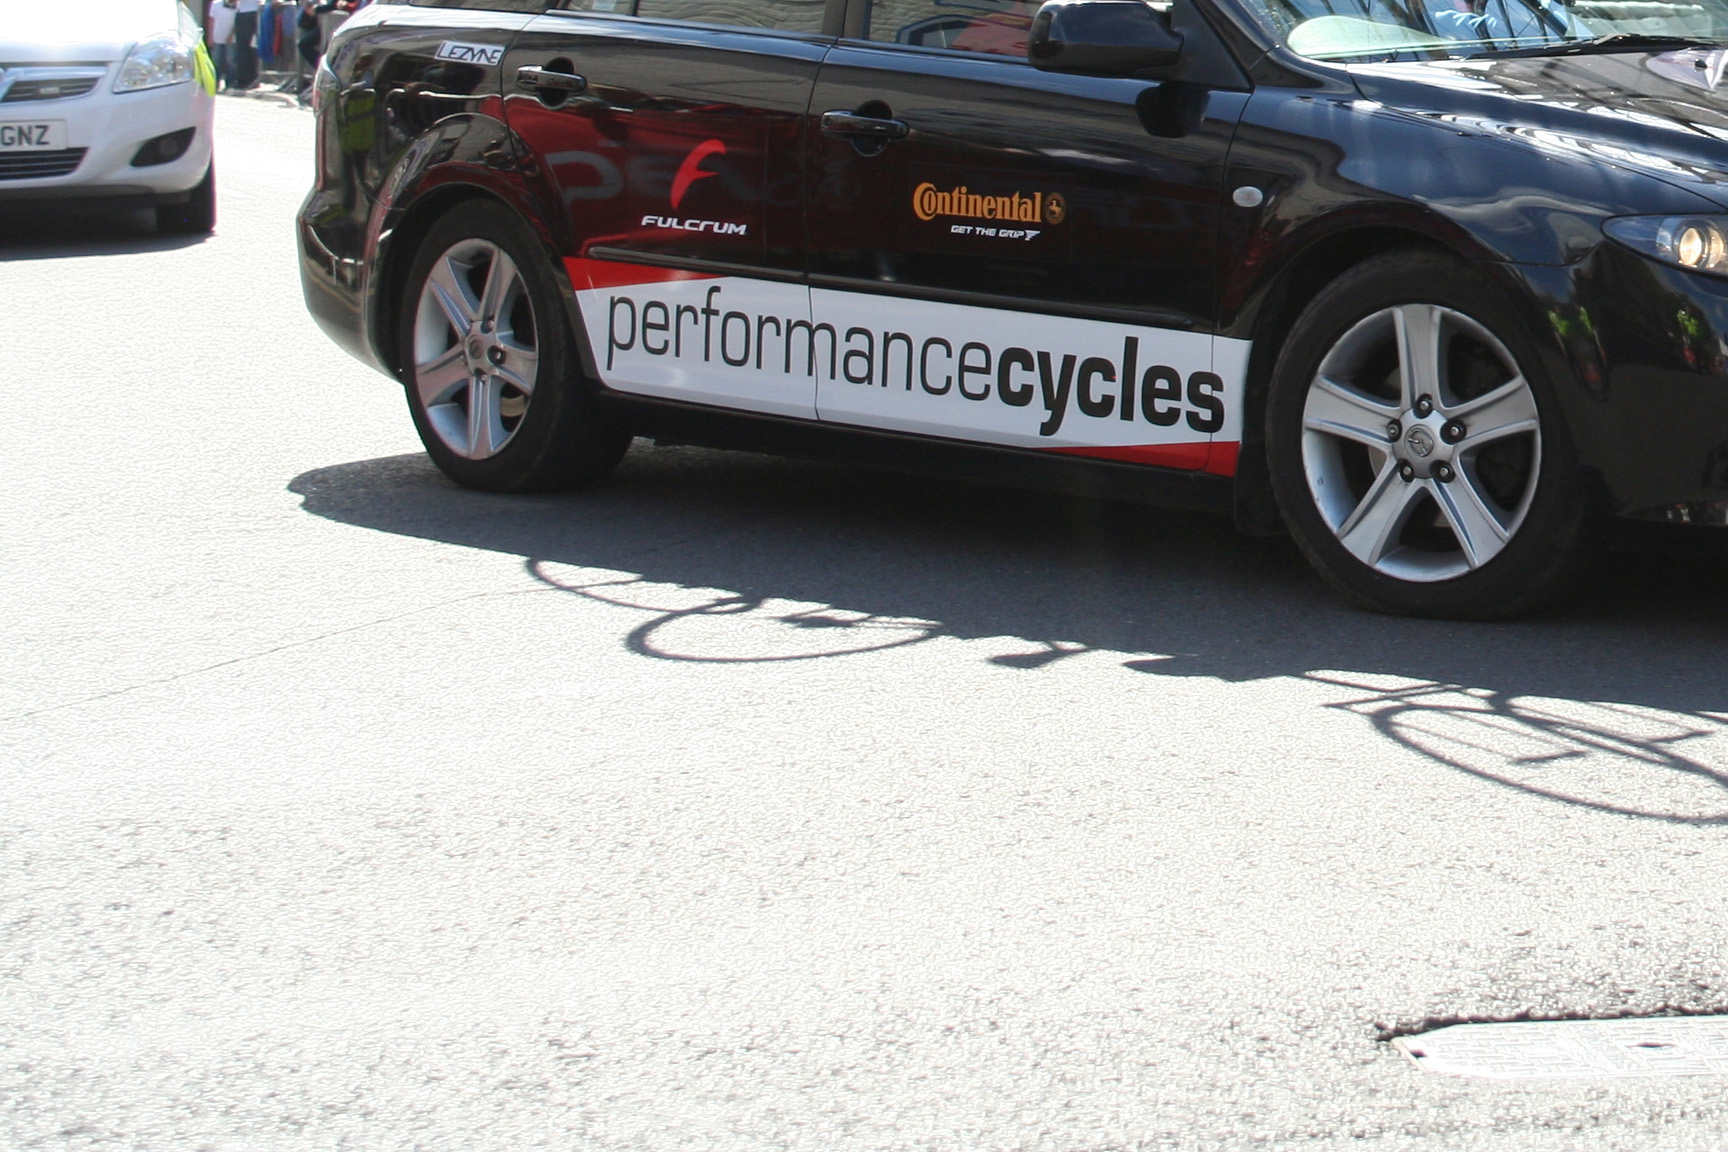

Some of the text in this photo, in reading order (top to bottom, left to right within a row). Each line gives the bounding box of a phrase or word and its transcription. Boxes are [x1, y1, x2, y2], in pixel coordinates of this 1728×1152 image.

[438, 42, 502, 64] LEZYNE
[1, 125, 50, 146] GNZ
[913, 182, 1043, 222] Continental
[641, 215, 748, 235] FULCRUM
[950, 225, 1025, 239] GET THE GRIP
[606, 286, 1225, 436] performancecycles
